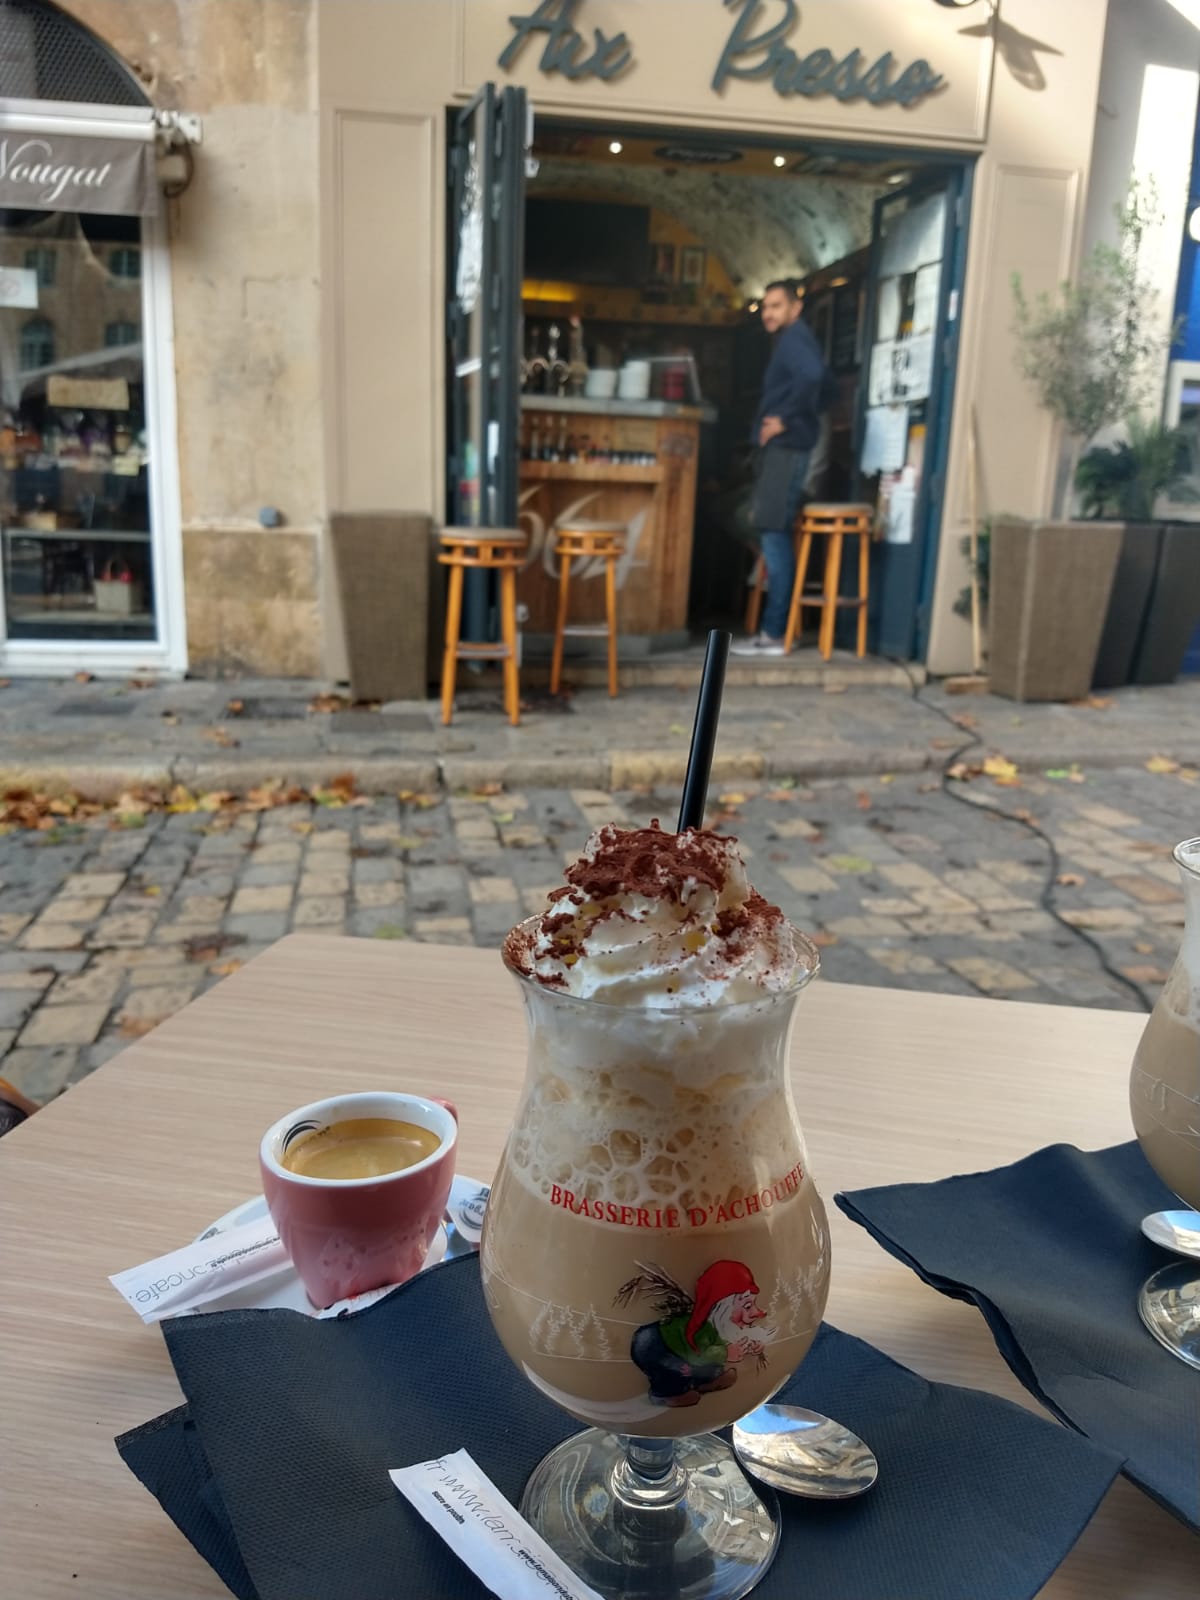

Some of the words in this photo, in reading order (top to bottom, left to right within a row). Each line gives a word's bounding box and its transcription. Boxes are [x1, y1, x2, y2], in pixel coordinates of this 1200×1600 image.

[0, 139, 111, 204] Nougat
[550, 1183, 681, 1228] BRASSERIE
[690, 1161, 804, 1228] D'ACHOUFFE
